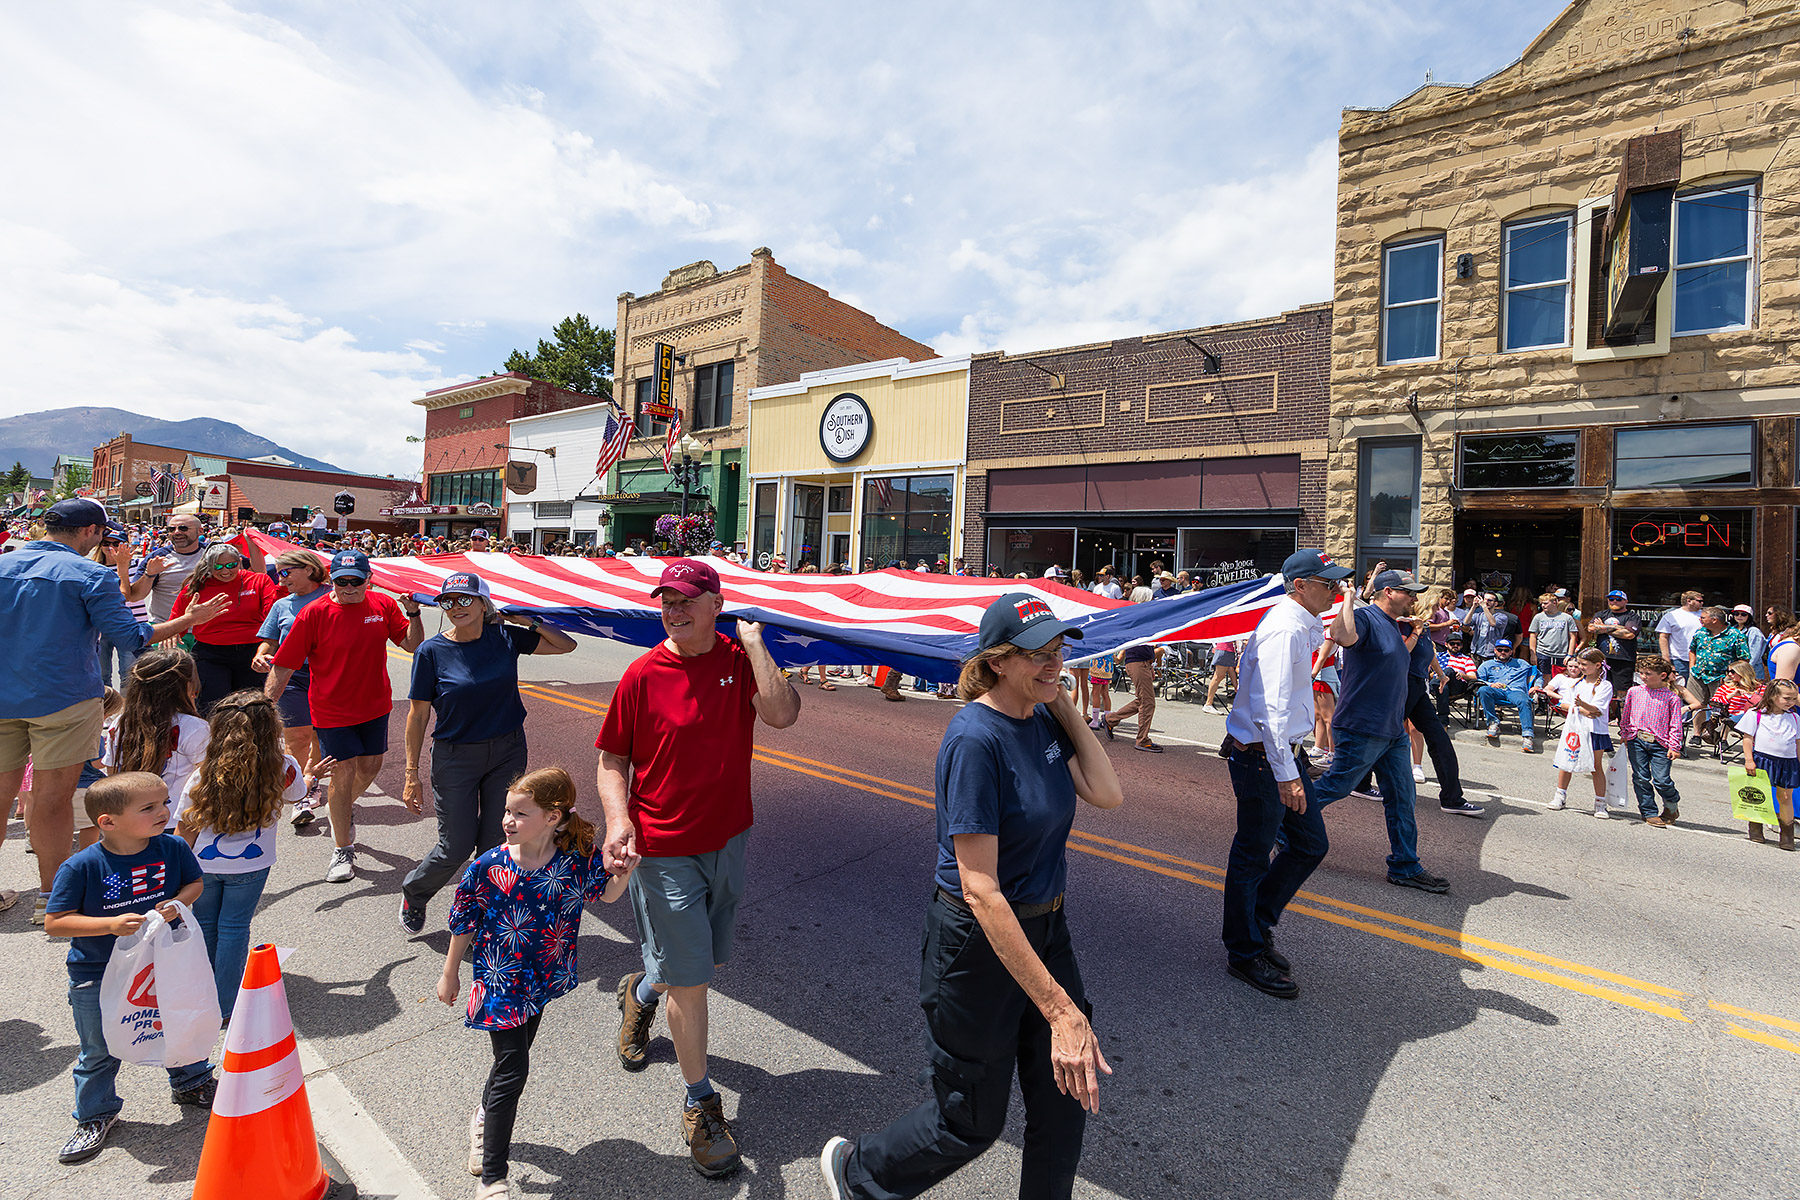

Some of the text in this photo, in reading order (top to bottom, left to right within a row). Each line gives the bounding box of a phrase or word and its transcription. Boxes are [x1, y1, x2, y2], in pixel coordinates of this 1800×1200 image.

[1567, 14, 1692, 60] BLACKBURN
[660, 344, 672, 405] FOLOS
[827, 413, 864, 431] SOUTHERN
[835, 427, 855, 445] DISH
[1630, 521, 1730, 547] OPEN
[1220, 559, 1255, 573] RED LODGE
[1210, 568, 1258, 587] JEWELERS
[103, 891, 165, 910] UNDER ARMOUR
[120, 1009, 161, 1025] HOME
